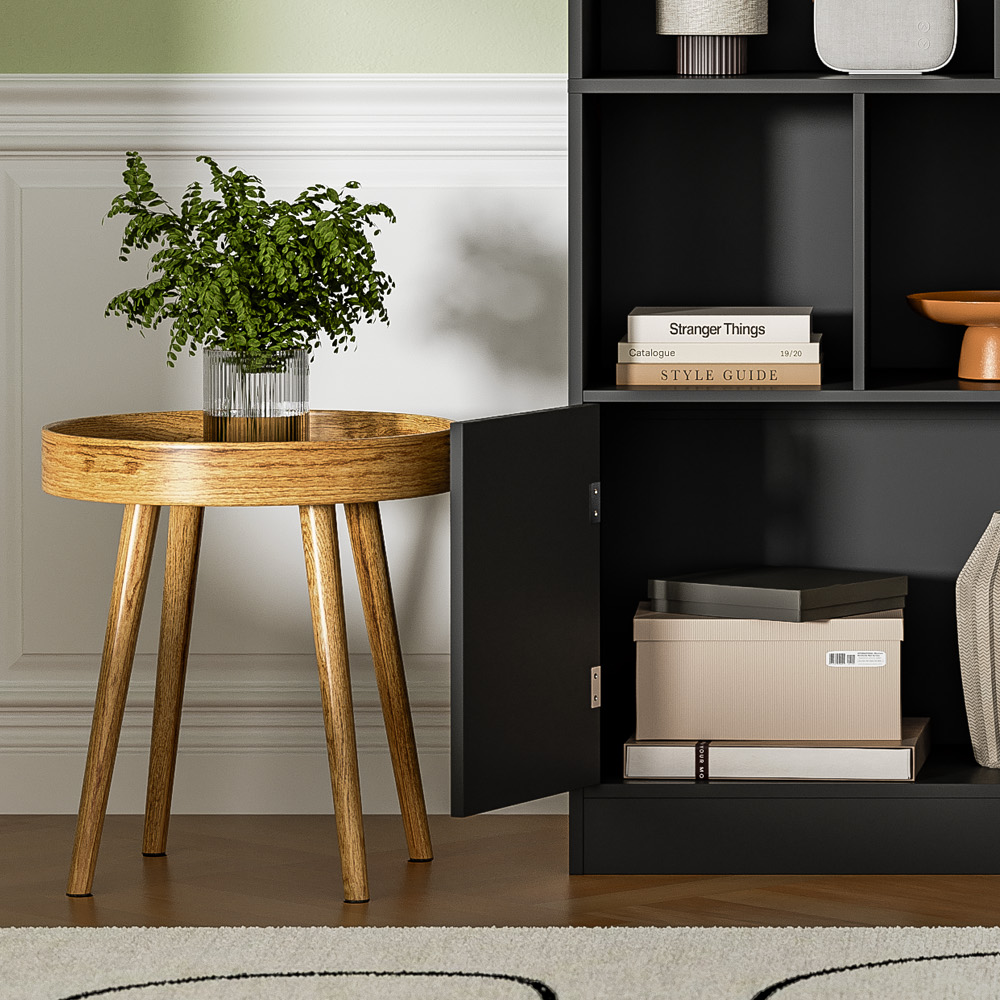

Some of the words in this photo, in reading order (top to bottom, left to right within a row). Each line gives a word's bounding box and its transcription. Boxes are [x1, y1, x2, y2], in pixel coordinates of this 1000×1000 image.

[669, 322, 721, 338] Stranger
[724, 322, 766, 338] Things
[629, 349, 675, 359] Catalogue
[660, 370, 714, 381] STYLE
[723, 370, 778, 381] GUIDE
